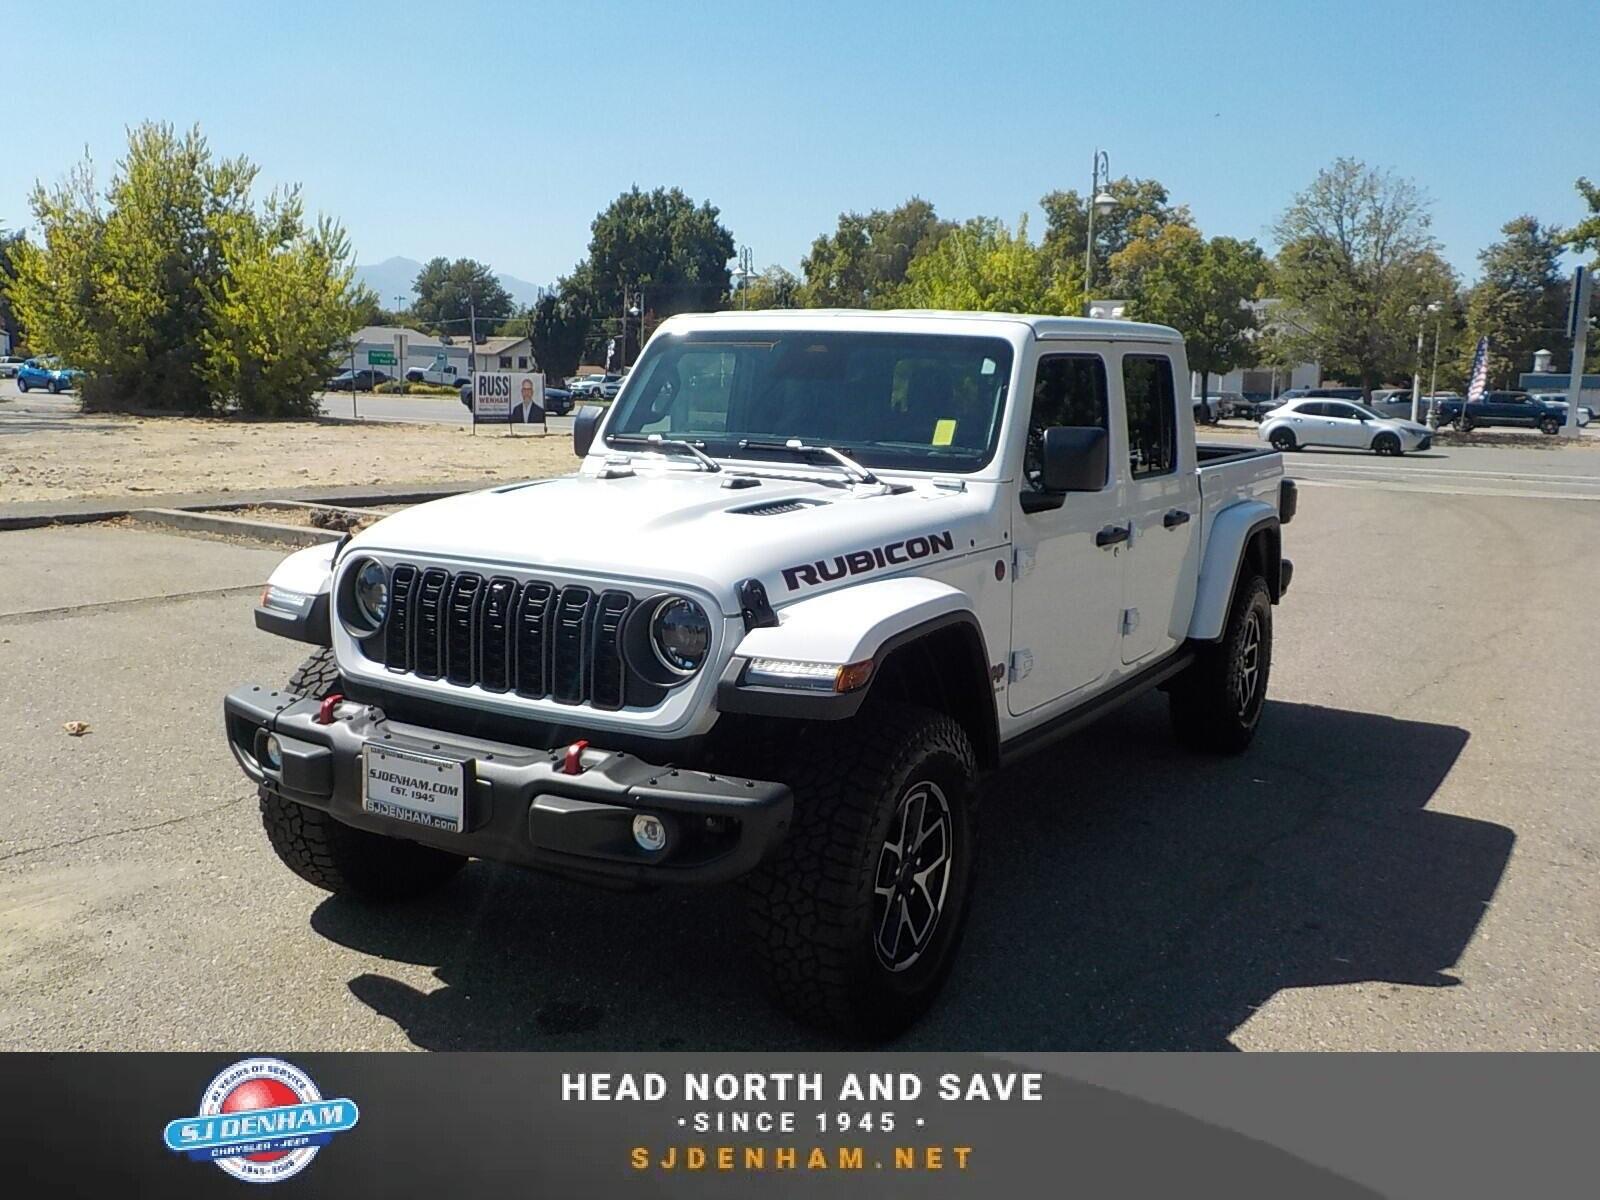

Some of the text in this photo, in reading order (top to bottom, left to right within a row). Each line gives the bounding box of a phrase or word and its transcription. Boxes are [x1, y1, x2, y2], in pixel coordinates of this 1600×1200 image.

[478, 375, 509, 396] RUSS
[781, 531, 954, 591] RUBICON
[369, 768, 459, 797] SJDENHAM.COM
[390, 785, 436, 802] EST. 1945
[367, 800, 457, 832] SJDENHAM.com
